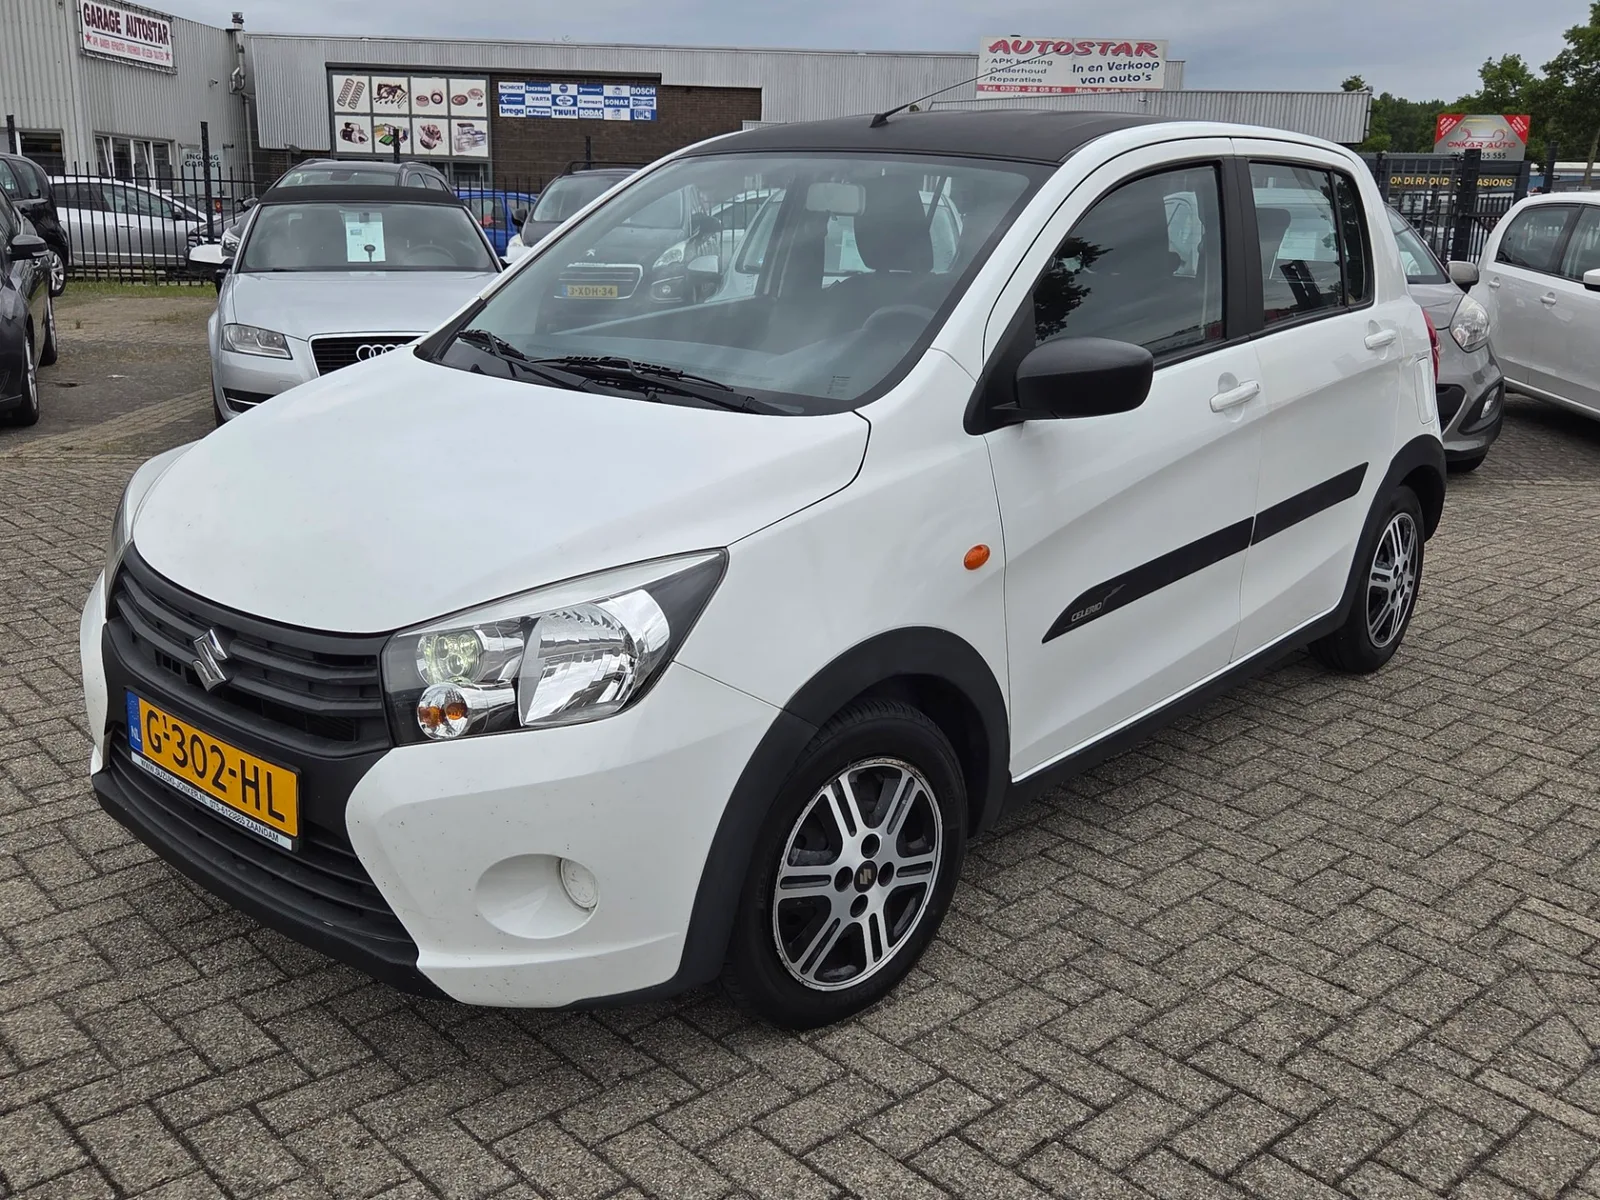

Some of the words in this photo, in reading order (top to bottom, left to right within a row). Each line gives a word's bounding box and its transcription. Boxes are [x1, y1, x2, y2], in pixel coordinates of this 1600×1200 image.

[83, 2, 121, 34] GARAGE
[126, 14, 169, 45] AUTOSTAR
[988, 39, 1159, 58] AUTOSTAR
[1016, 58, 1053, 66] keuring
[1072, 64, 1084, 73] In
[1107, 61, 1160, 71] Verkoop
[990, 67, 1047, 75] Onderhoud
[1080, 76, 1105, 84] van
[1109, 72, 1152, 83] auto's
[630, 87, 656, 95] BOSCH
[500, 106, 525, 115] brega
[186, 153, 219, 161] INGNG
[184, 160, 221, 168] GARGE
[1071, 601, 1103, 622] CELERIO
[130, 725, 142, 743] NL
[245, 818, 280, 843] ZAANDAM
